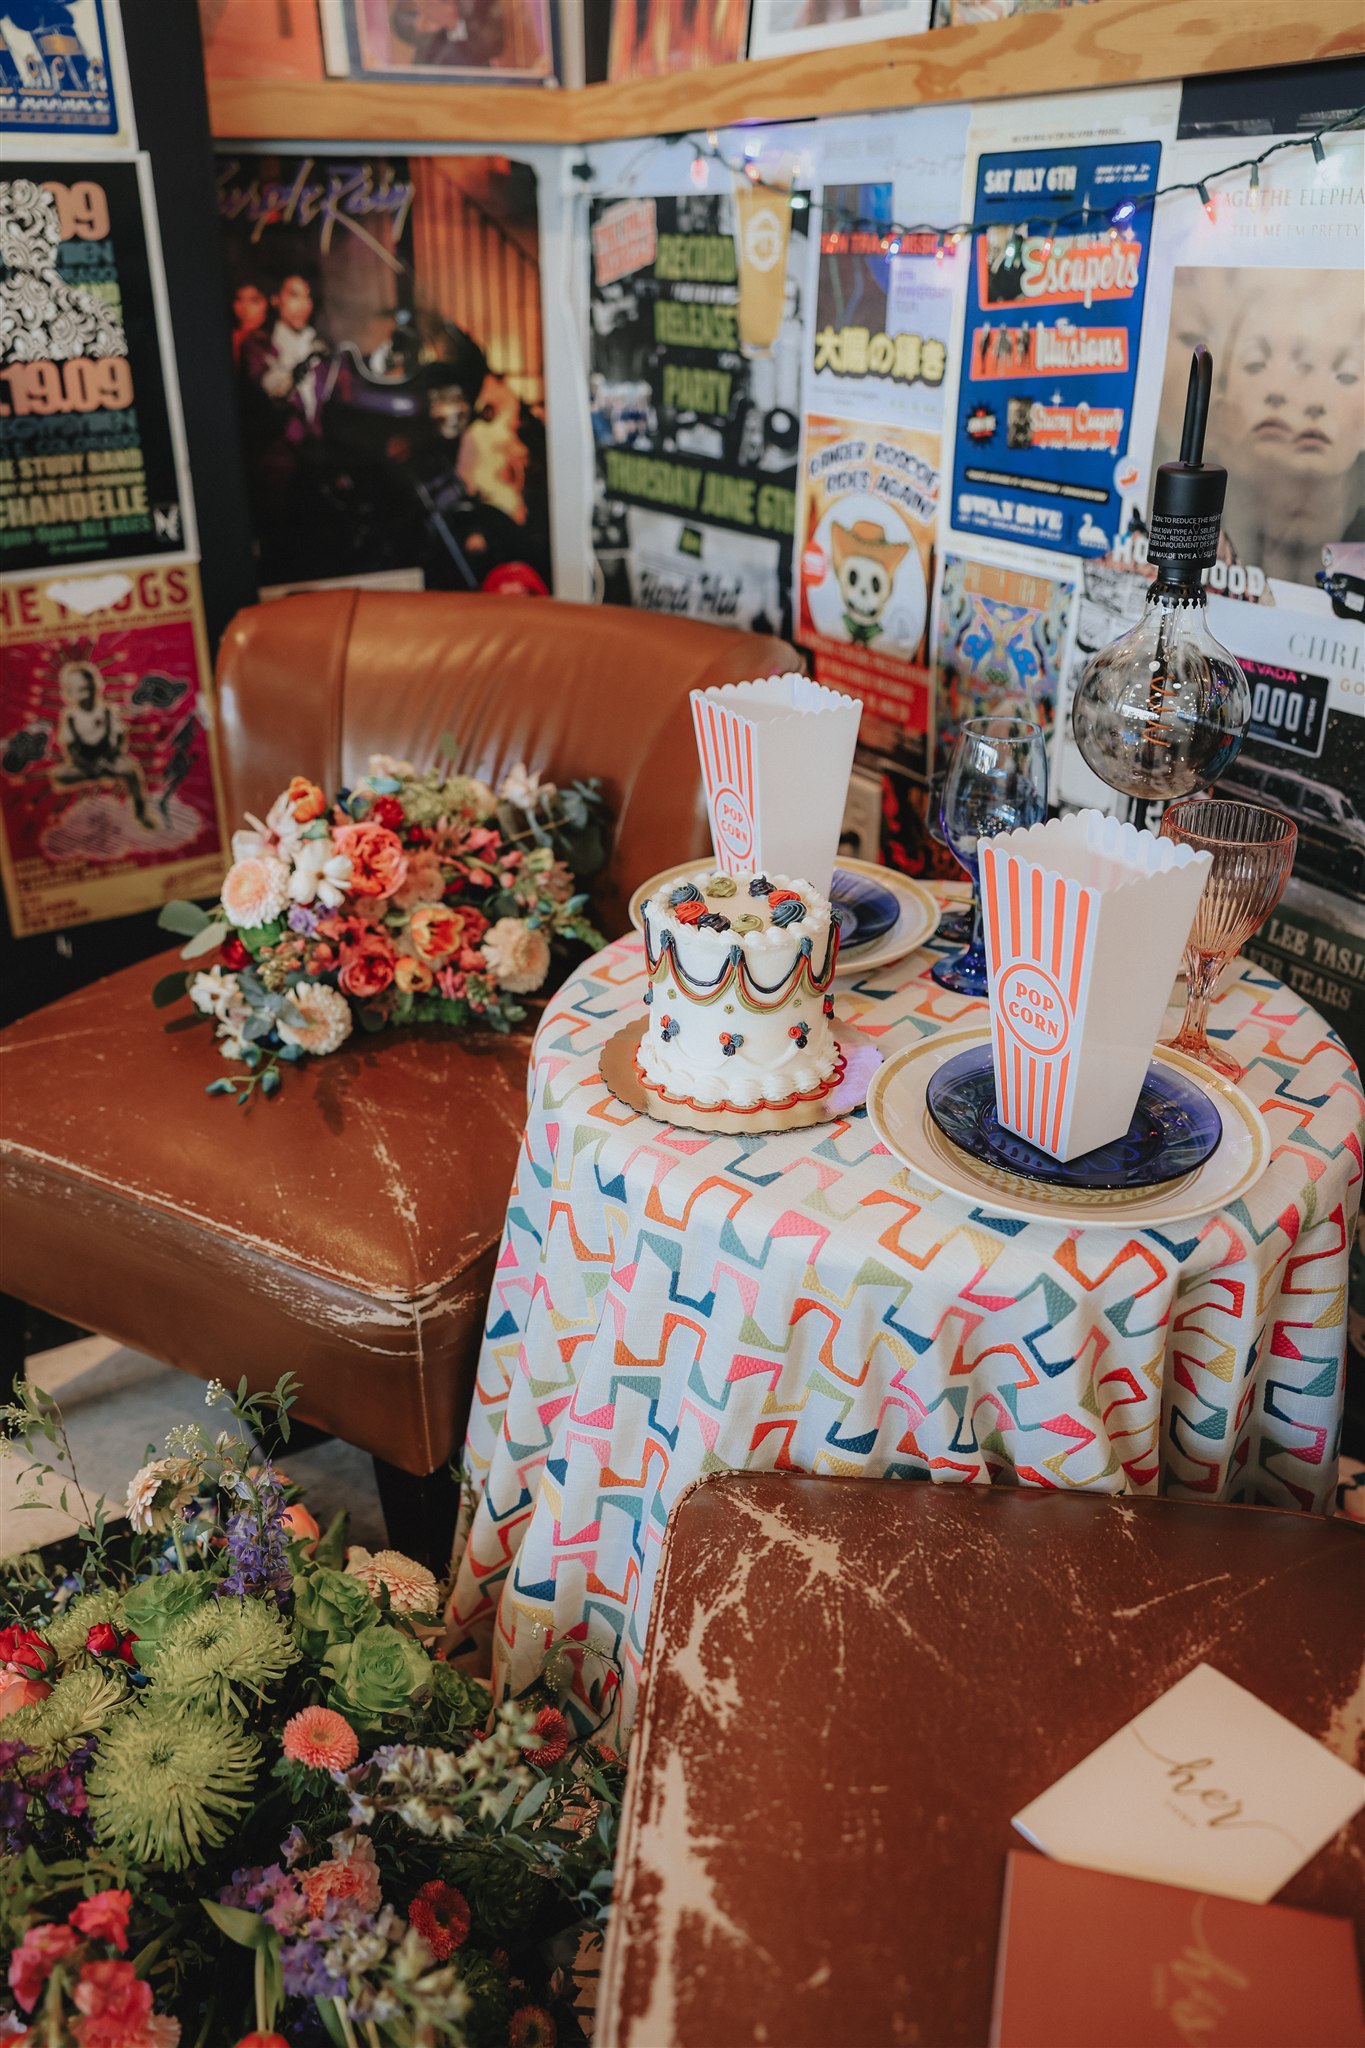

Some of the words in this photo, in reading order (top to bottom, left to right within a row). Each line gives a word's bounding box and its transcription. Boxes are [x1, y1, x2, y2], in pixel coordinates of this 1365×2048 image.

[984, 168, 1012, 194] SAT
[1012, 166, 1046, 193] JULY
[1046, 165, 1078, 192] 6TH
[1258, 189, 1292, 208] THE
[1311, 222, 1362, 237] PRETTY
[1020, 236, 1139, 309] Escapers
[662, 364, 732, 417] PARTY
[605, 451, 703, 511] THURSDAY
[701, 471, 757, 526] JUNE
[1172, 517, 1196, 525] REDUCE
[1197, 516, 1208, 524] THE
[1173, 528, 1187, 536] TYPE
[1160, 541, 1199, 549] UNIQUEMENT
[1169, 535, 1192, 544] RISQUE
[1177, 552, 1192, 560] TYPE
[1288, 631, 1365, 673] CHRI
[722, 803, 744, 824] POP
[720, 819, 748, 843] CORN
[1015, 981, 1054, 1012] POP
[1289, 964, 1352, 1011] TEARS
[1008, 1001, 1058, 1039] CORN
